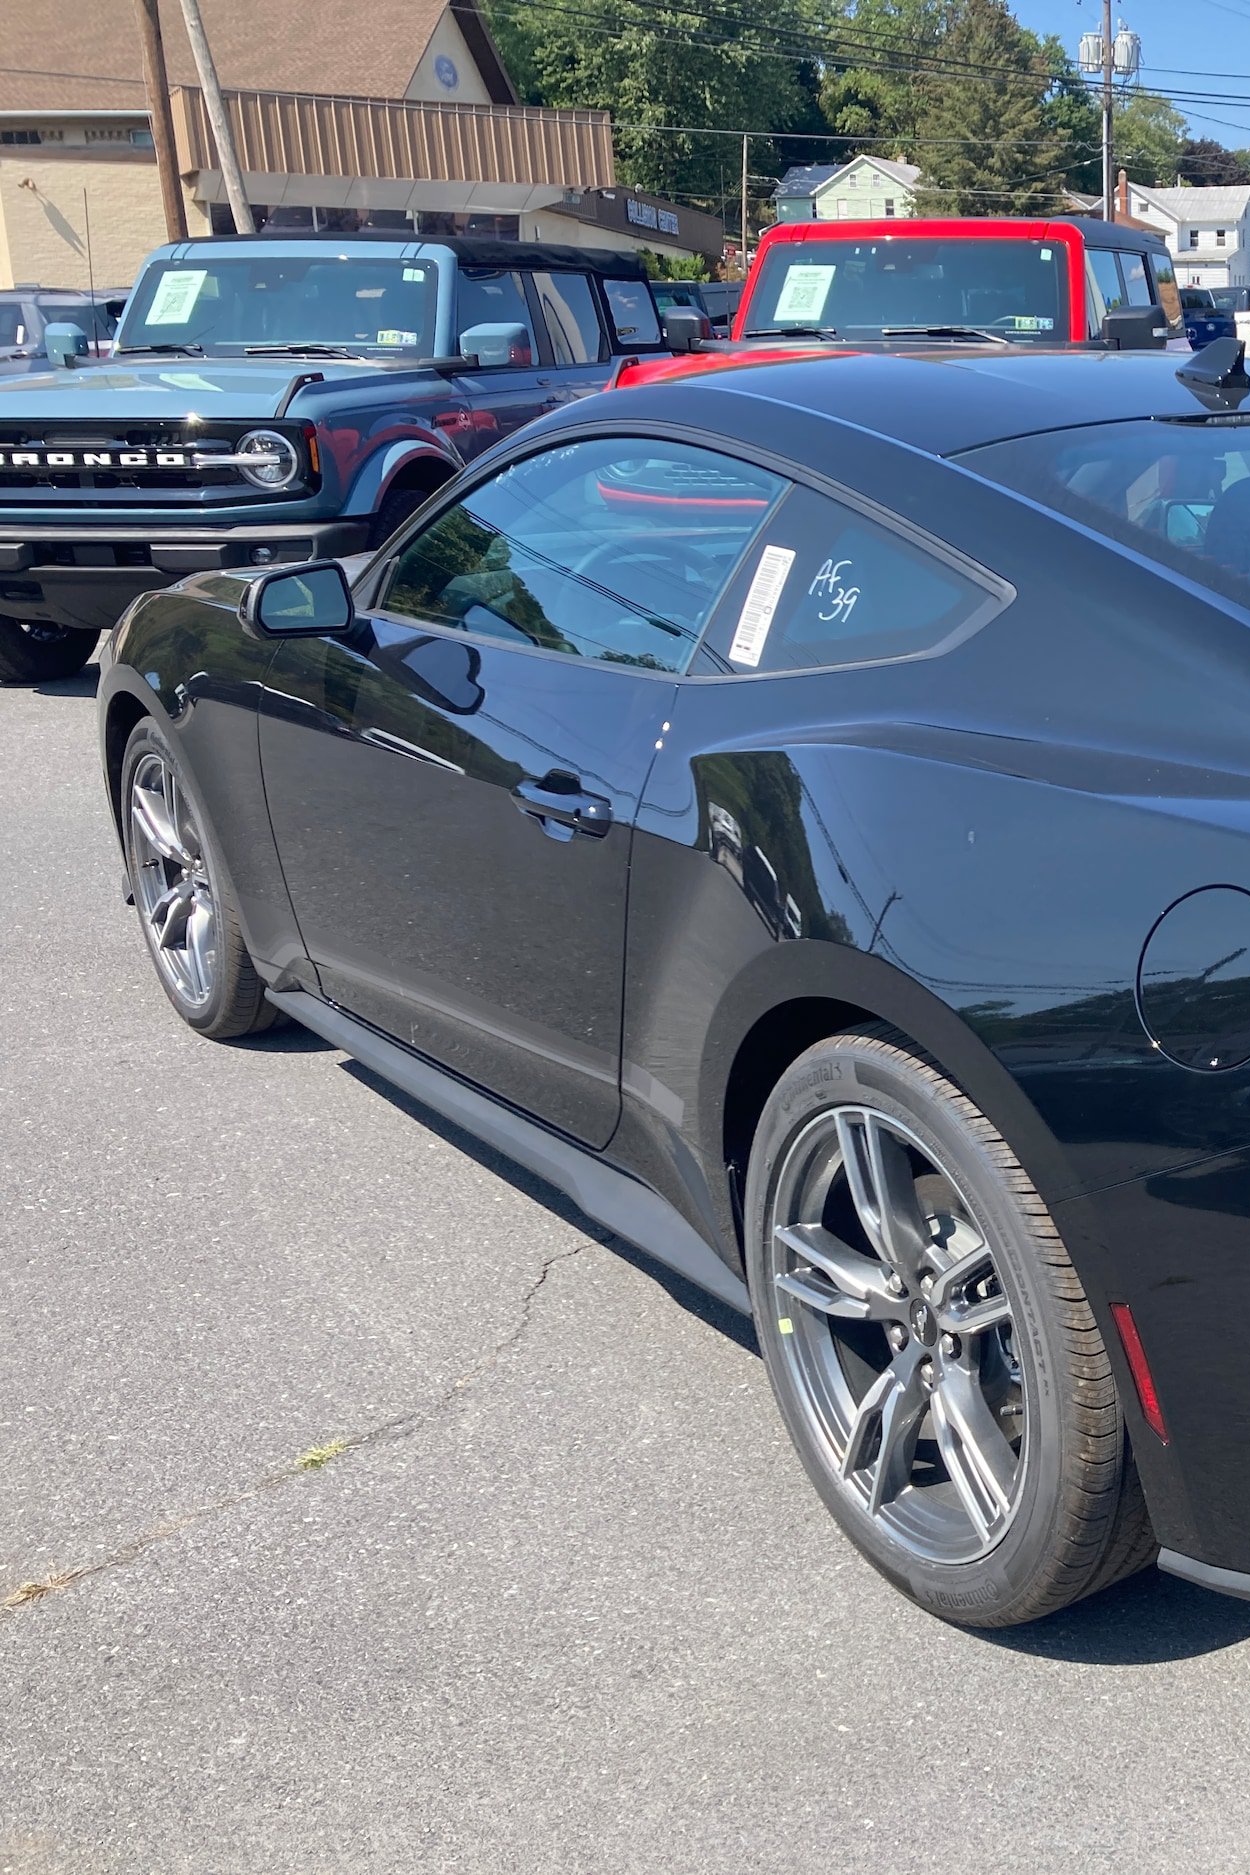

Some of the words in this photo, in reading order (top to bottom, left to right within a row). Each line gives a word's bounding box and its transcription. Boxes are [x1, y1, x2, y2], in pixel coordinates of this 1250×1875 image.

[0, 453, 184, 466] RONCO
[818, 587, 860, 623] 39
[935, 1578, 1001, 1609] Continental
